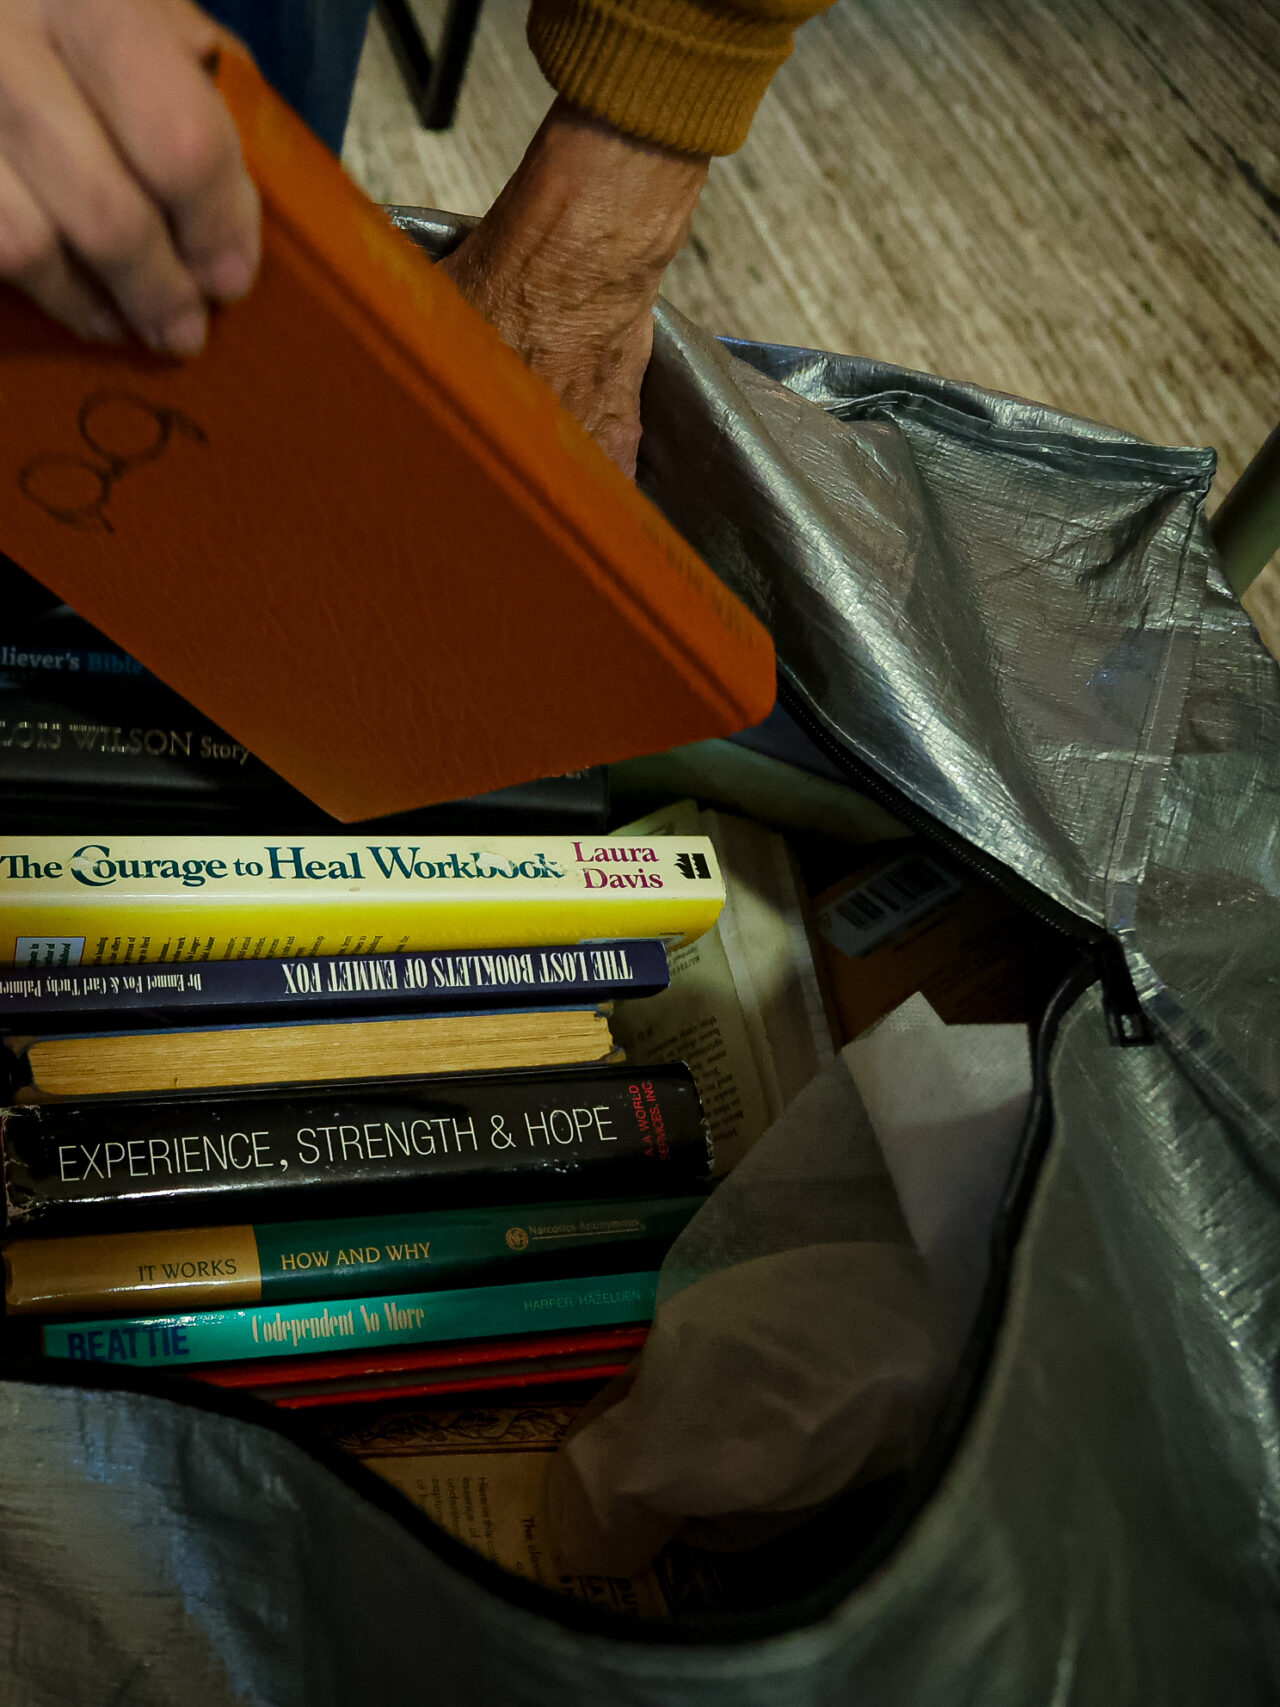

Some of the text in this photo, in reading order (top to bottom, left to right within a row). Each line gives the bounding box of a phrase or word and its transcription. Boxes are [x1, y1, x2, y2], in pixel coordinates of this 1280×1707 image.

[67, 723, 195, 761] WILSON
[198, 734, 250, 768] Story
[70, 843, 228, 888] Courage
[233, 856, 264, 879] to
[263, 845, 366, 880] Heal
[365, 845, 565, 880] Workbook
[570, 840, 659, 863] Laura
[582, 867, 664, 890] Davis
[280, 961, 323, 996] FOX
[327, 958, 399, 993] EMMET
[402, 956, 429, 990] OF
[433, 953, 536, 988] BOOKLETS
[538, 951, 590, 984] LOST
[591, 948, 634, 981] THE
[45, 975, 81, 998] Tuchy
[82, 975, 108, 996] Carl
[108, 975, 121, 994] &
[122, 974, 143, 994] Fox
[145, 973, 184, 993] Emmet
[184, 972, 203, 991] Dr
[627, 1083, 650, 1132] WORLD
[57, 1103, 619, 1184] EXPERIENCE, STRENGTH & HOPE
[137, 1241, 432, 1282] IT WORKS HOW AND WHY
[66, 1301, 425, 1364] BEATTIE Codependent No More
